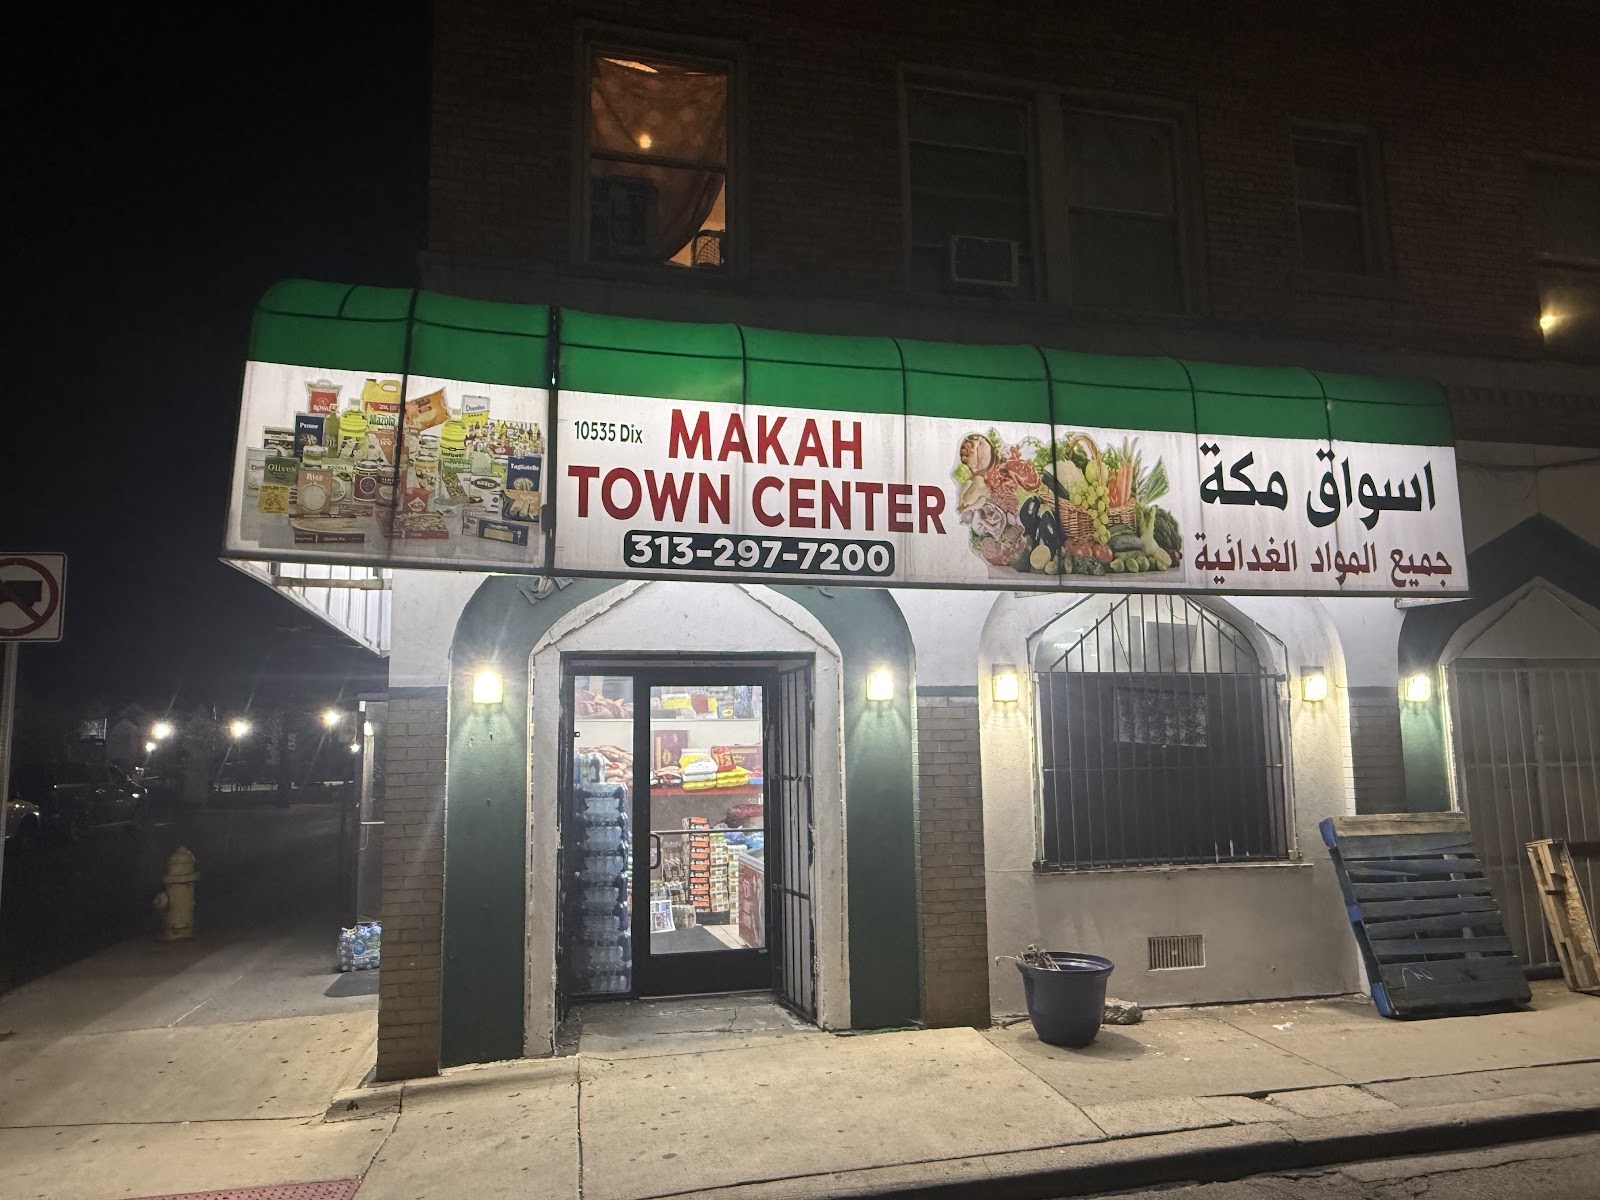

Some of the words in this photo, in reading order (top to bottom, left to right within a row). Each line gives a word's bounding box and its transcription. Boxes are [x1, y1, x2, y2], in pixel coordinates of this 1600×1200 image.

[574, 420, 616, 442] 10535
[620, 422, 643, 444] Dix
[668, 408, 863, 470] MAKAH
[567, 465, 730, 525] TOWN
[752, 476, 947, 535] CENTER
[1200, 442, 1288, 511] مكة
[1306, 448, 1436, 531] اسواق
[629, 534, 891, 573] 313-297-7200
[1310, 540, 1377, 585] المواد
[1389, 548, 1453, 588] جميع
